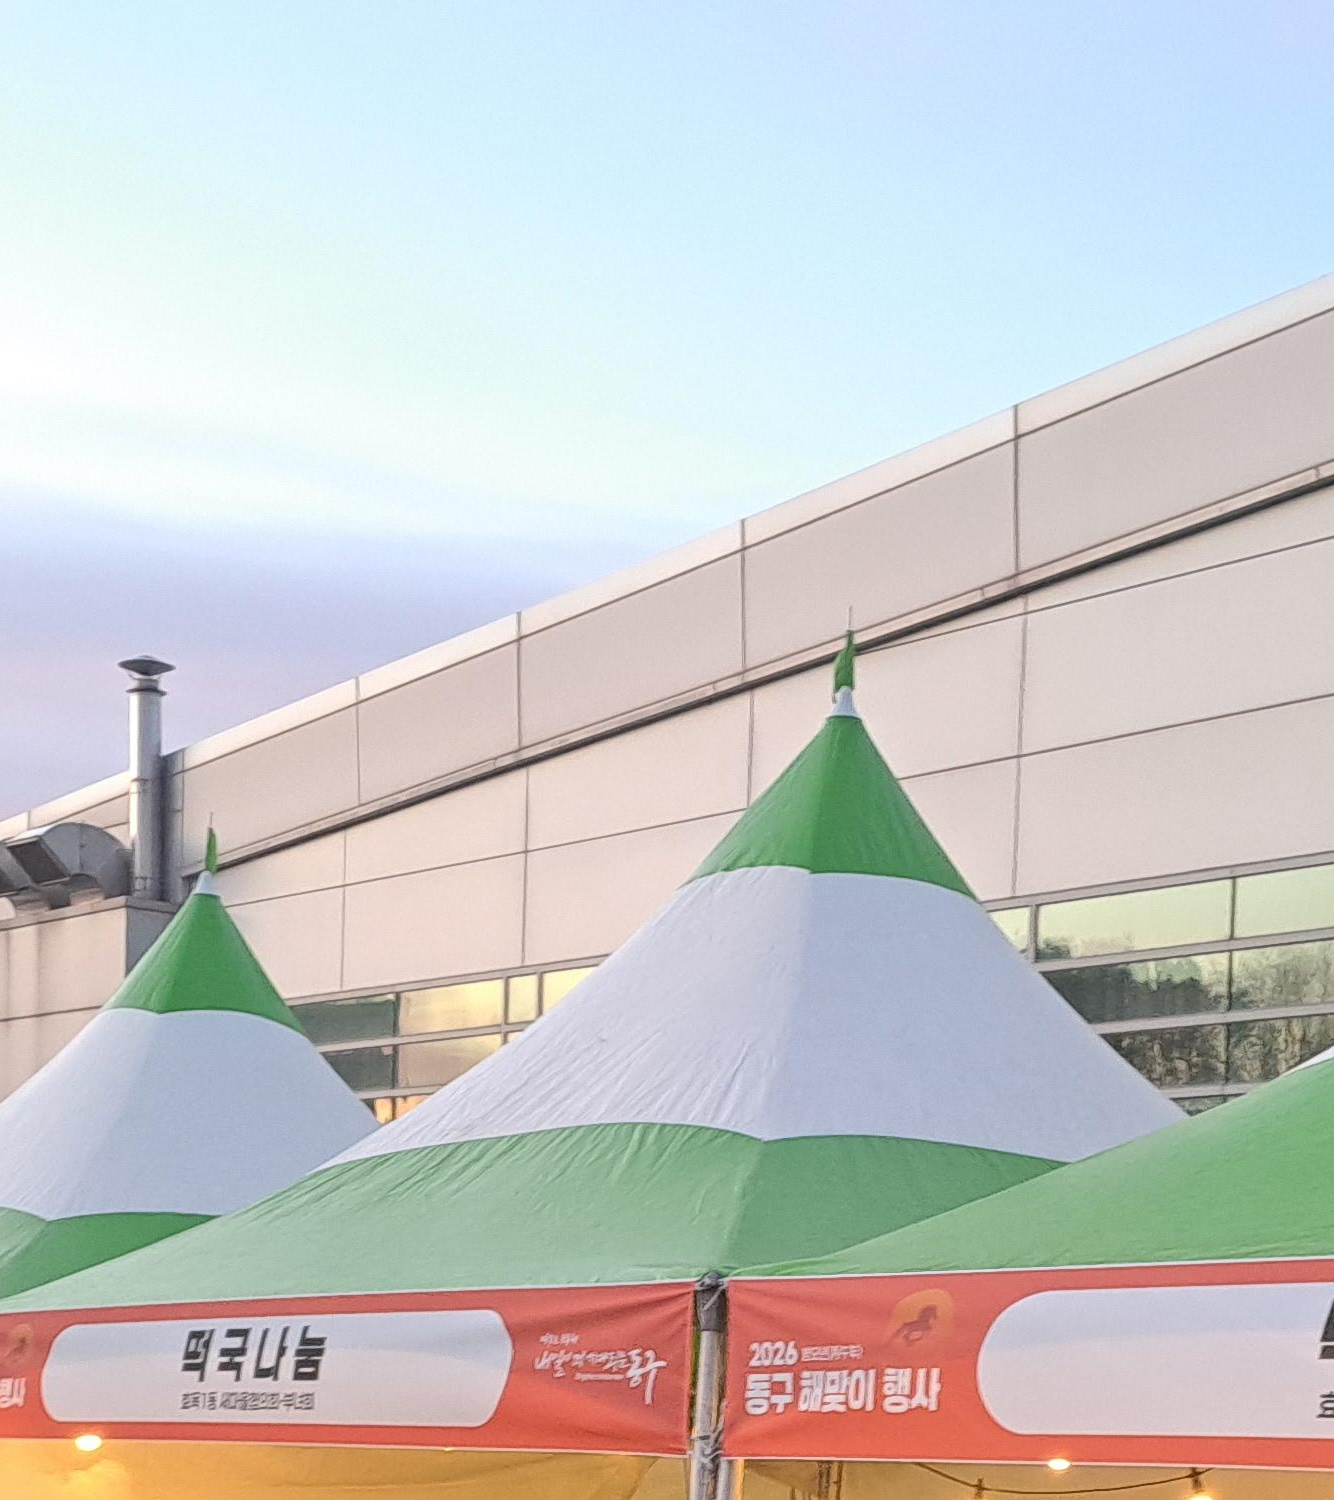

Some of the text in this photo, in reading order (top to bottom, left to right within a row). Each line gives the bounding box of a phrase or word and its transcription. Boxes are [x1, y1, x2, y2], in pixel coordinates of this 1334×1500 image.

[181, 1325, 328, 1382] 떡국나눔
[748, 1340, 799, 1368] 2026
[745, 1367, 941, 1415] 동구 해맞이 행사
